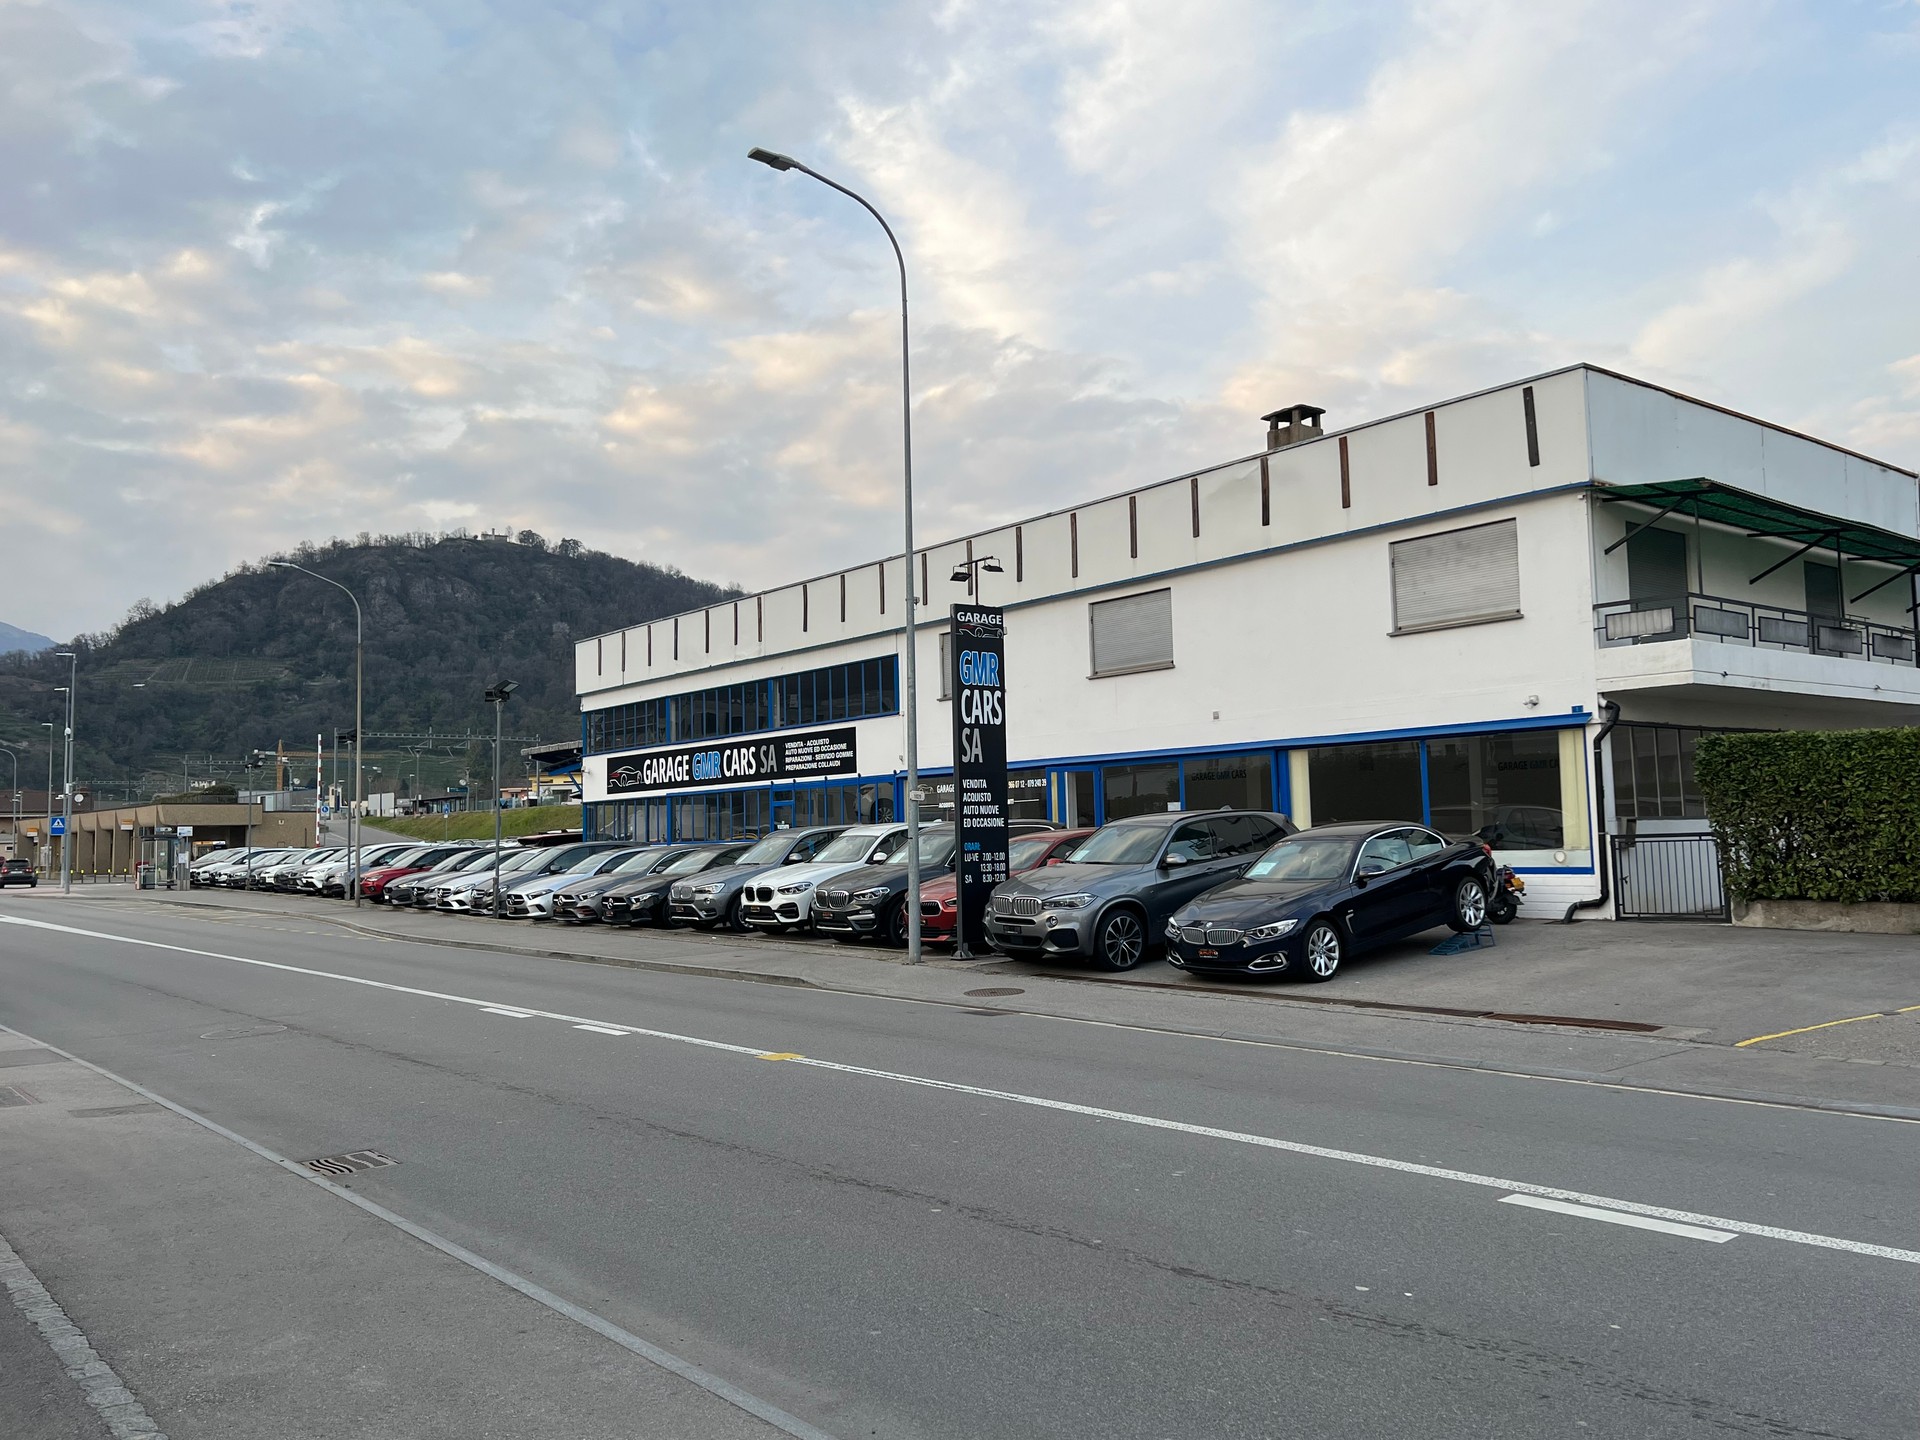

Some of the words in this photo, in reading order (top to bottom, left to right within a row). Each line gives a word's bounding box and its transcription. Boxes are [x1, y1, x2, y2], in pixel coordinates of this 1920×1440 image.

[957, 611, 1002, 625] GARAGE
[959, 650, 1000, 687] GMR
[961, 688, 1003, 725] CARS
[785, 741, 804, 749] VENDITA
[806, 738, 830, 747] ACQUISTO
[797, 746, 813, 754] NUOVE
[820, 743, 847, 751] OCCASIONE
[961, 727, 984, 763] SA
[785, 754, 812, 763] RIPARAZIONI
[815, 752, 835, 760] SERVIZIO
[835, 750, 854, 758] GOMME
[643, 755, 690, 784] GARAGE
[692, 751, 722, 781] GMR
[723, 746, 757, 777] CARS
[759, 744, 778, 774] SA
[785, 762, 818, 771] PREPARAZIONE
[818, 760, 841, 768] COLLAUDI
[1497, 760, 1528, 772] GARAGE
[1191, 771, 1216, 781] GARAGE
[1231, 769, 1247, 779] CARS
[936, 783, 955, 793] GARAGE
[962, 779, 987, 789] VENDITA
[962, 792, 992, 802] ACQUISTO
[962, 805, 979, 815] AUTO
[980, 805, 1000, 815] NUOVE
[963, 818, 971, 828] ED
[972, 817, 1005, 828] OCCASIONE
[964, 874, 973, 884] SA
